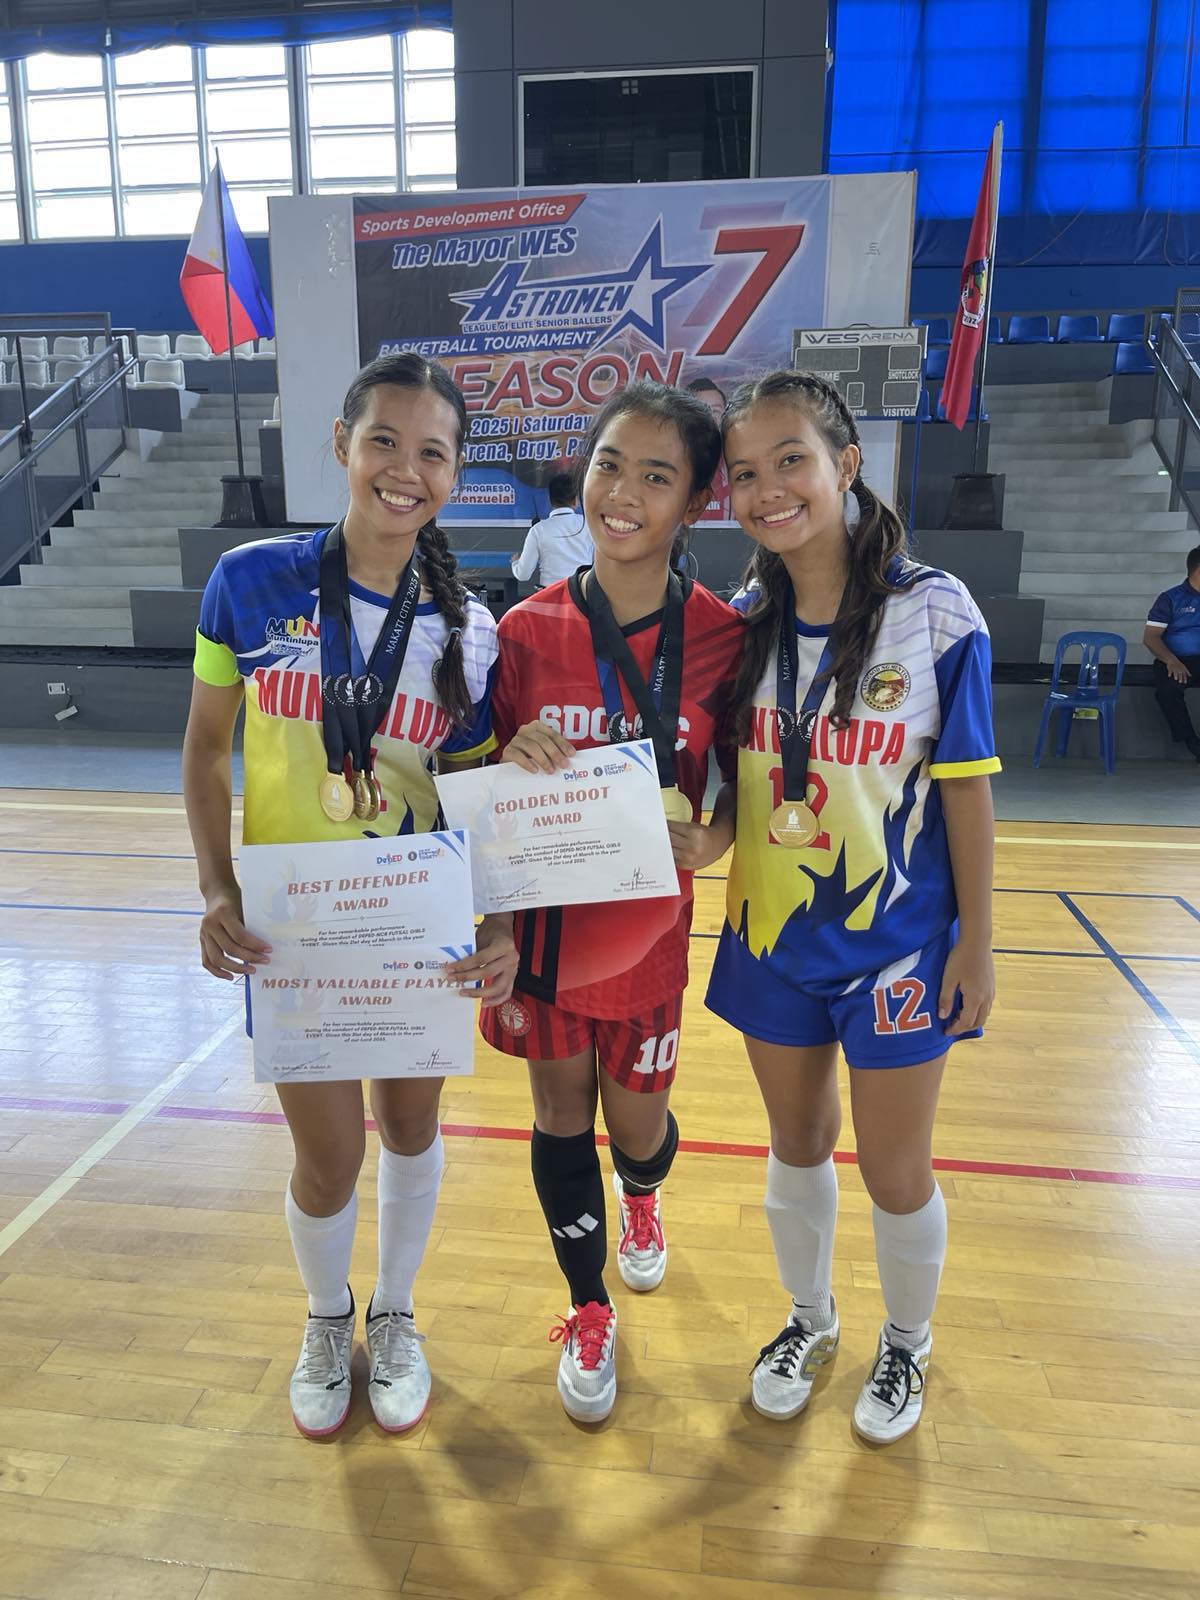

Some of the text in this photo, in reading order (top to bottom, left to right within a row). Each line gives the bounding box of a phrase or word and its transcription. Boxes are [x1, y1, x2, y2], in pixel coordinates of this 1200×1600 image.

[361, 203, 566, 235] Sports Development Office
[393, 227, 578, 268] The Mayor WES
[461, 262, 634, 322] ASTROMEN
[696, 224, 805, 356] 7
[463, 322, 496, 333] LEAGUE
[512, 321, 534, 330] ELITE
[536, 318, 570, 328] SENIOR
[572, 316, 612, 325] BALLERS
[378, 330, 596, 358] BASKETBALL TOURNAMENT
[454, 351, 685, 411] EASON
[888, 371, 919, 380] SHOTCLOCK
[882, 408, 917, 416] VISITOR
[471, 418, 509, 436] 2025
[518, 440, 561, 459] Brgy.
[450, 494, 514, 504] alenzuela!
[386, 577, 418, 655] MAKATI CITY 2025
[266, 634, 319, 646] Muntinlupa
[653, 656, 667, 692] MAKATI
[494, 786, 611, 814] GOLDEN BOOT
[532, 812, 582, 828] AWARD
[288, 870, 430, 896] BEST DEFENDER
[332, 896, 389, 912] AWARD
[262, 978, 312, 989] MOST
[317, 978, 401, 989] VALUABLE
[338, 996, 392, 1006] AWARD
[870, 977, 932, 1035] 12
[632, 1028, 679, 1074] 10
